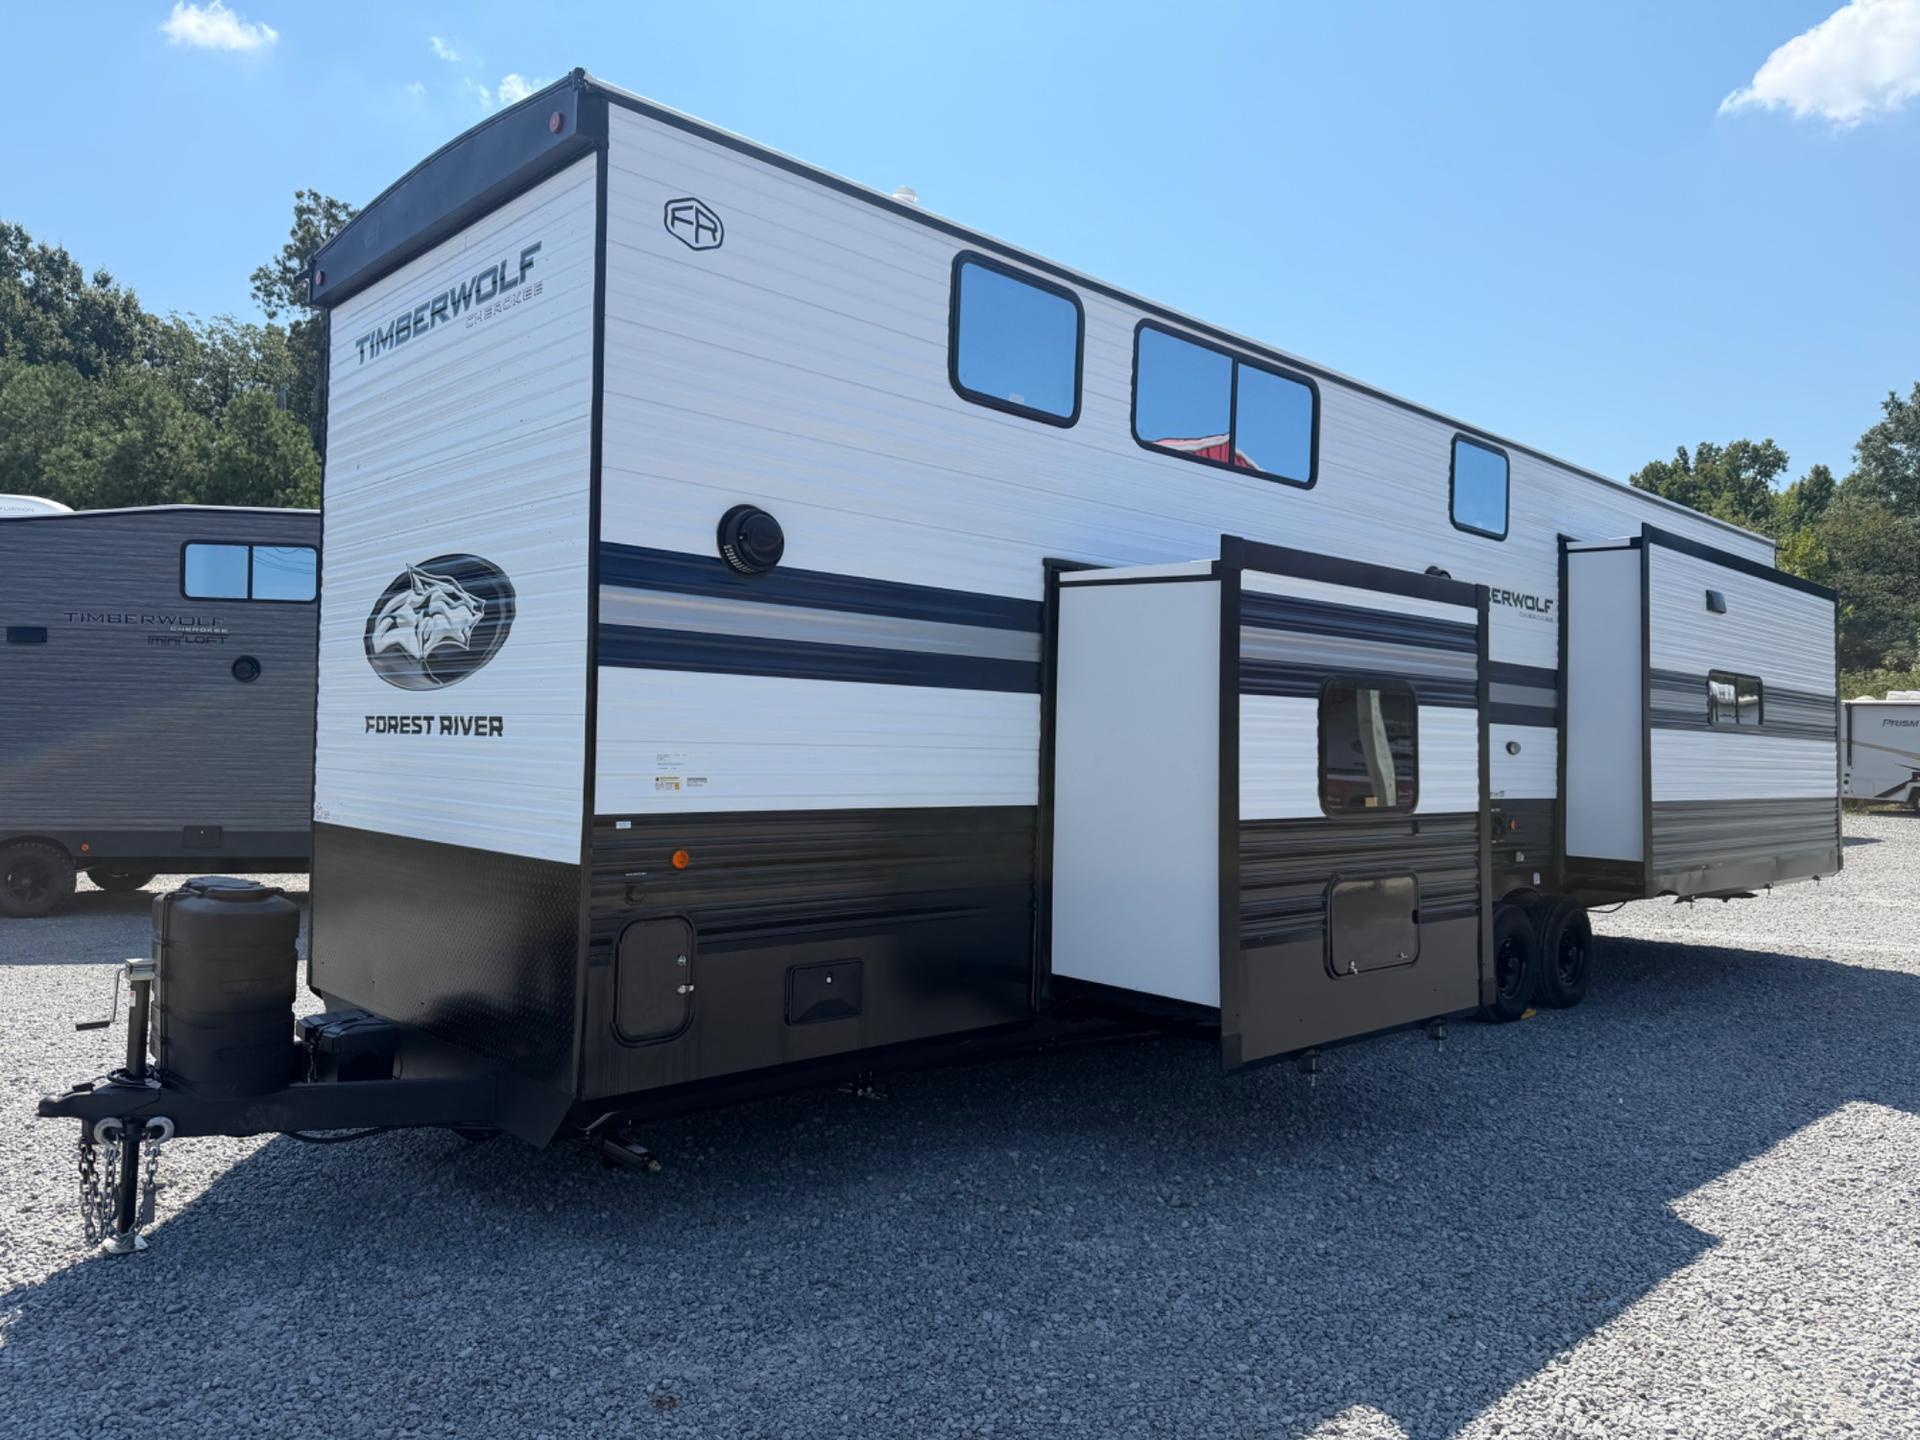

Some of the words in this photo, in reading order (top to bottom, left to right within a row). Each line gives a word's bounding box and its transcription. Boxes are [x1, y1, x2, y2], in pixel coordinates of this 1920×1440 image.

[355, 239, 542, 366] TIMBERWOLF
[464, 281, 544, 329] CHEROKEE
[1489, 587, 1554, 613] ERWOLF
[63, 611, 225, 626] TIMBERWOLF
[364, 715, 435, 735] FOREST
[439, 715, 504, 737] RIVER
